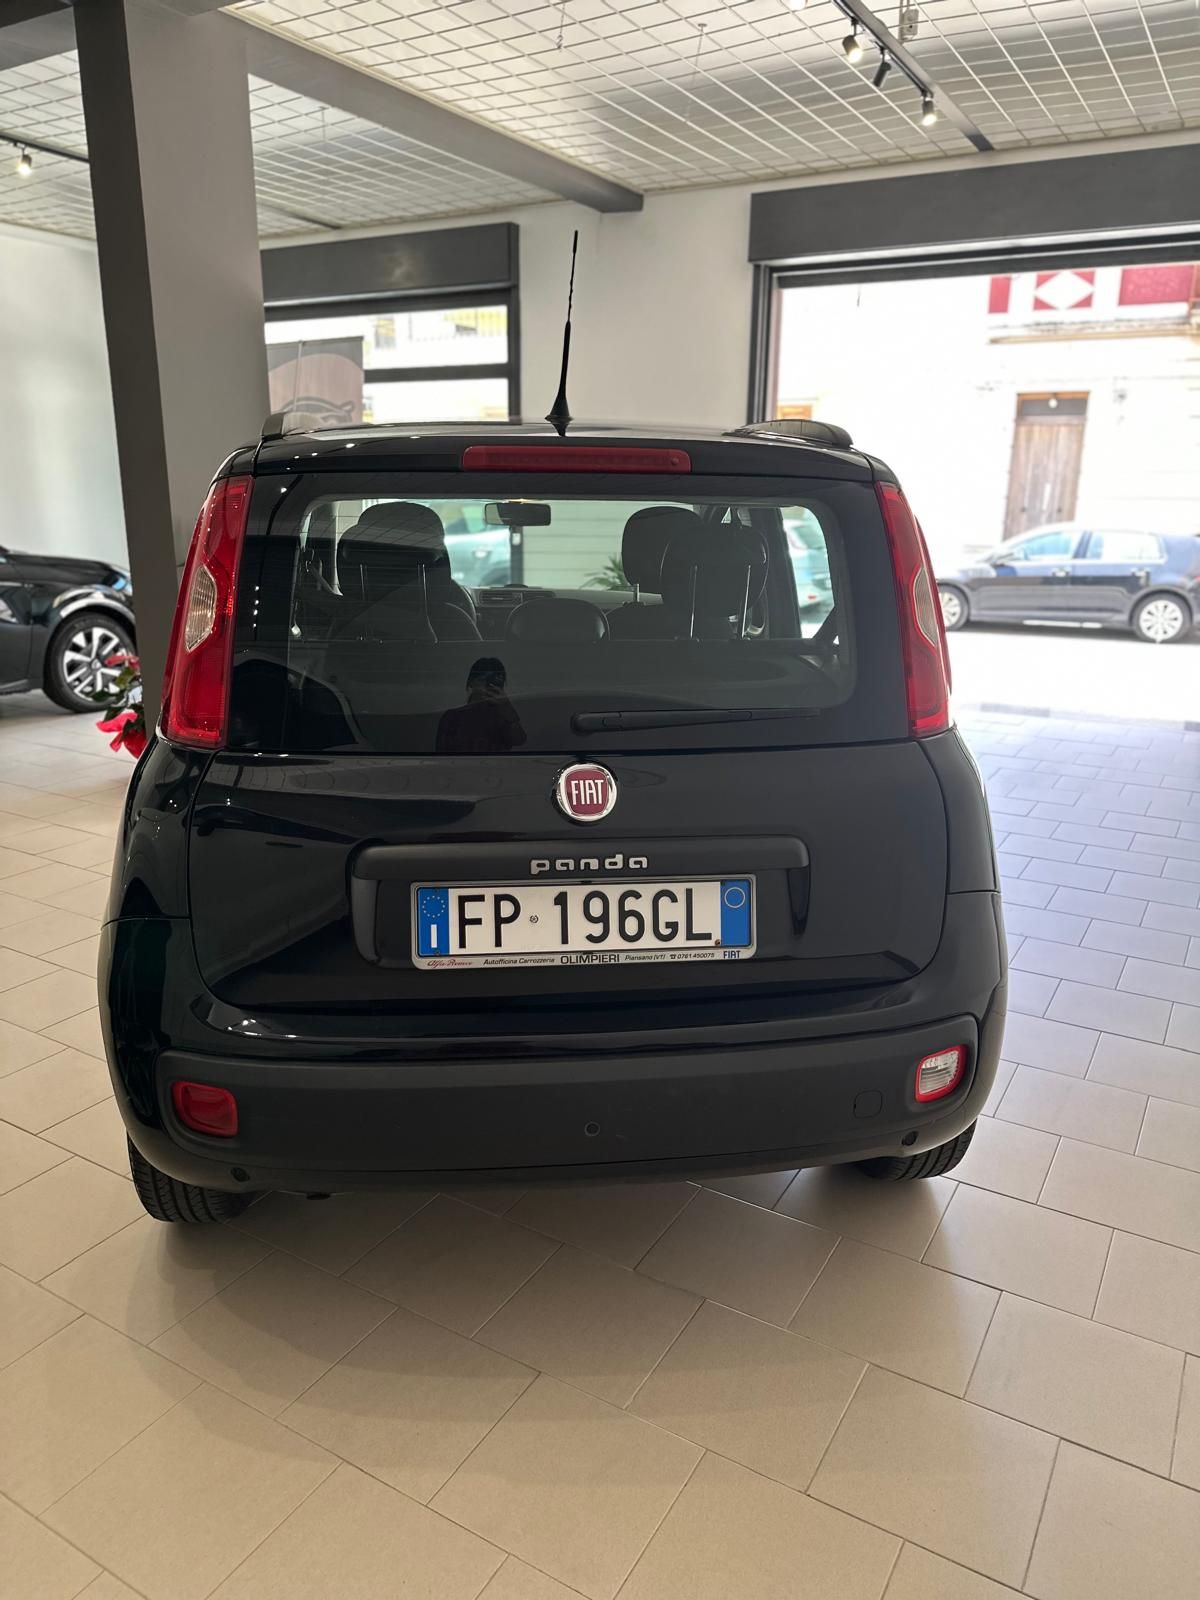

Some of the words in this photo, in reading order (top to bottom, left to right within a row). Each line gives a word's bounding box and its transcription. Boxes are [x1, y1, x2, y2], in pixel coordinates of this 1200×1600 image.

[571, 780, 604, 805] FIAT
[530, 854, 648, 875] panda
[457, 893, 521, 949] FP
[553, 888, 712, 945] 196GL
[483, 957, 518, 966] Autofficina
[518, 957, 555, 965] Carrozzeria
[560, 953, 620, 965] OLIMPIERI
[723, 950, 741, 959] FIAT
